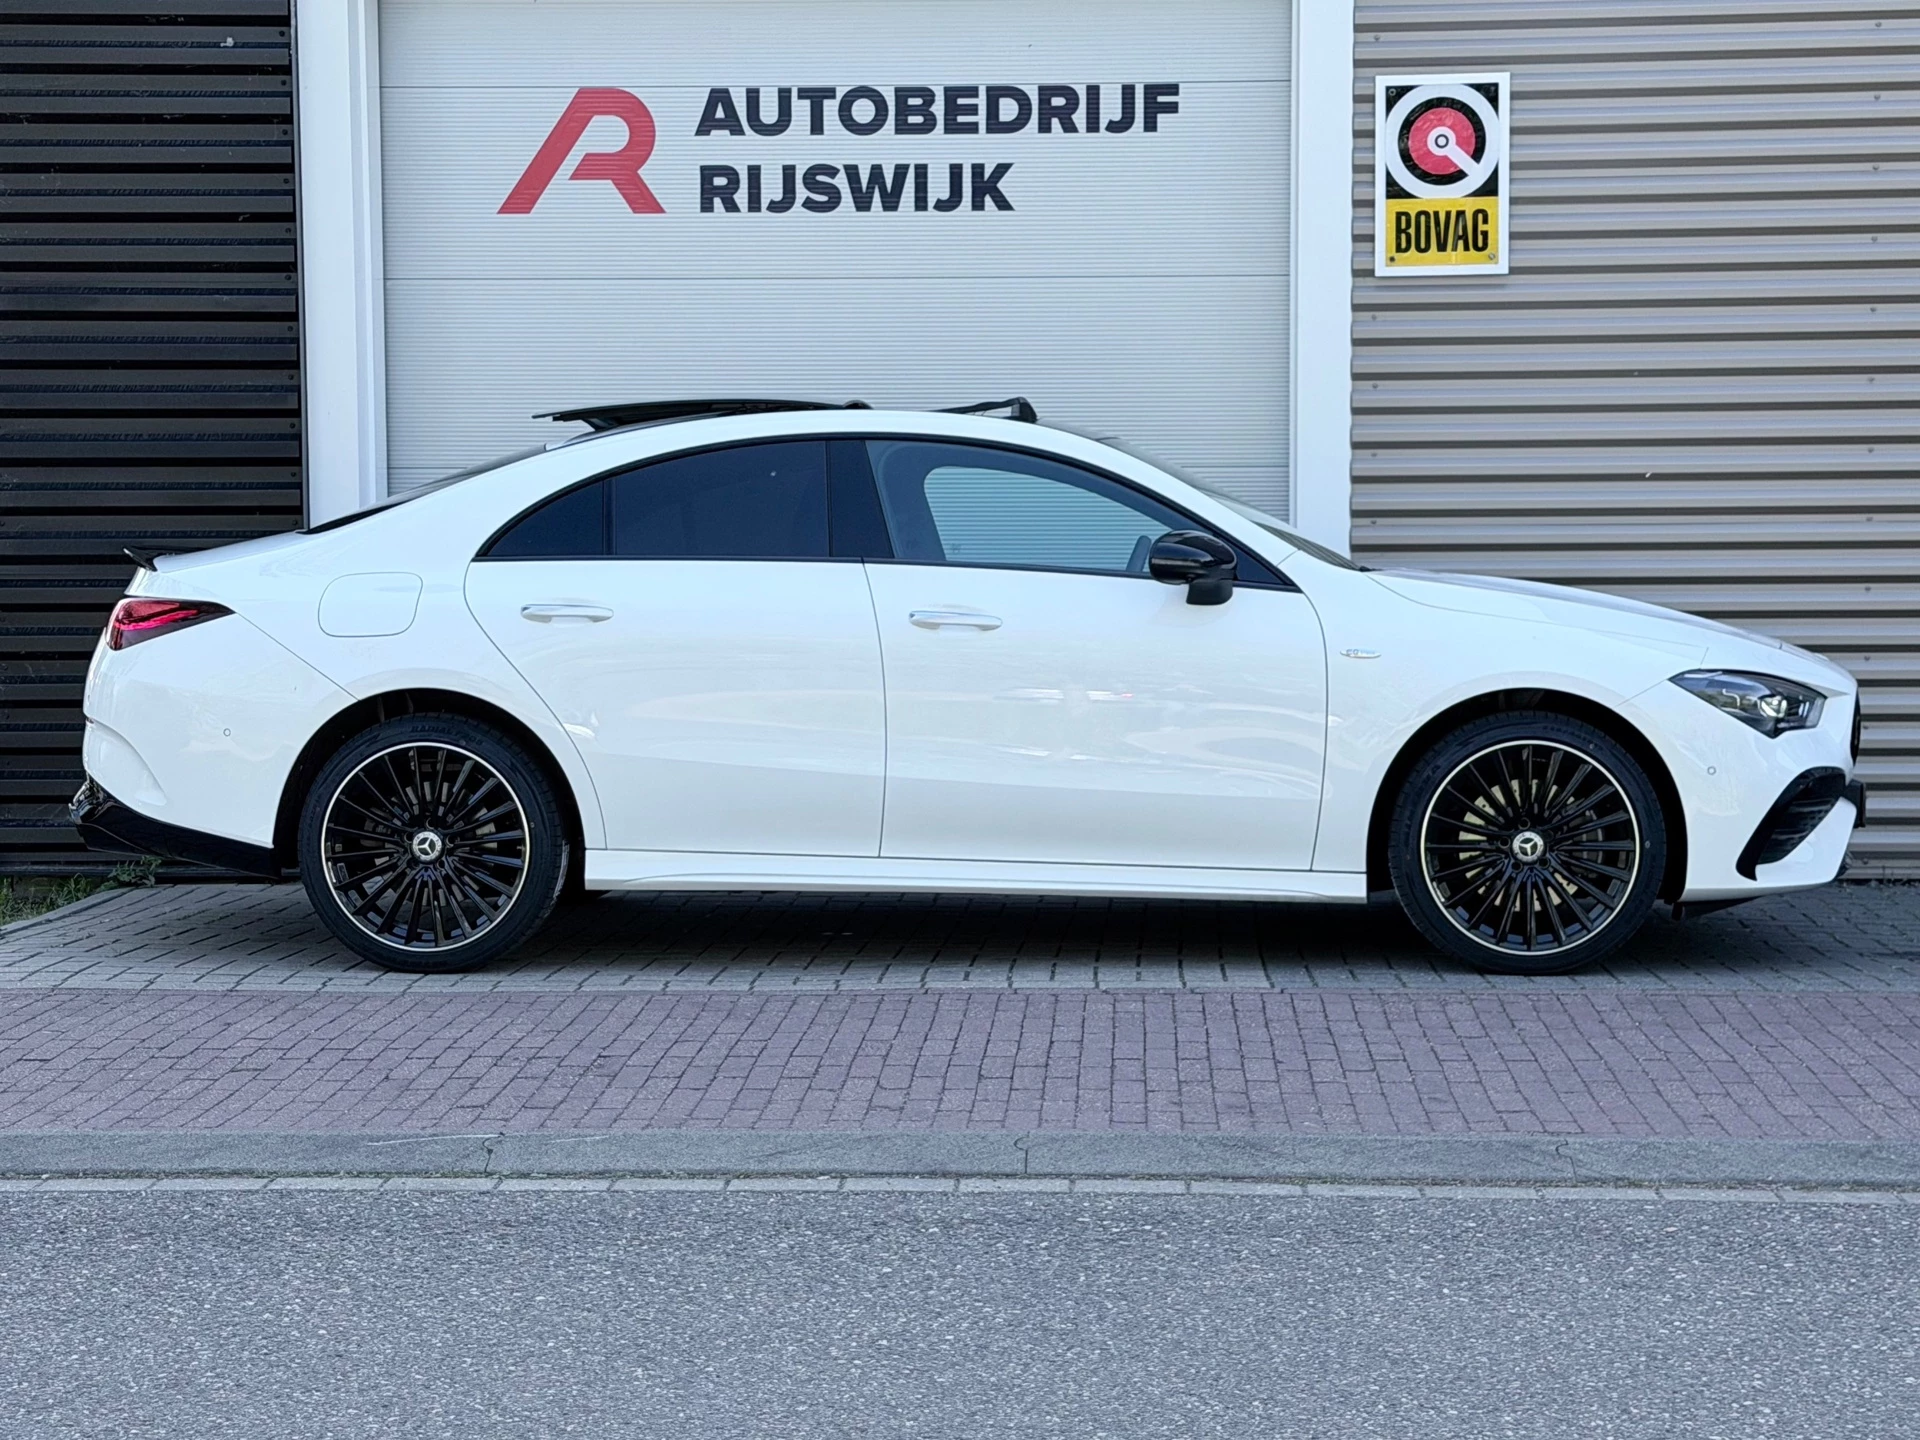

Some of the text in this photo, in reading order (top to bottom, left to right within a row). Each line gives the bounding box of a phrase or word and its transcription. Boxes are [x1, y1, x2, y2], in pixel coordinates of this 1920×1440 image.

[694, 83, 1180, 136] AUTOBEDRIJF
[699, 162, 1016, 214] RIJSWIJK
[1394, 208, 1489, 255] BOVAG
